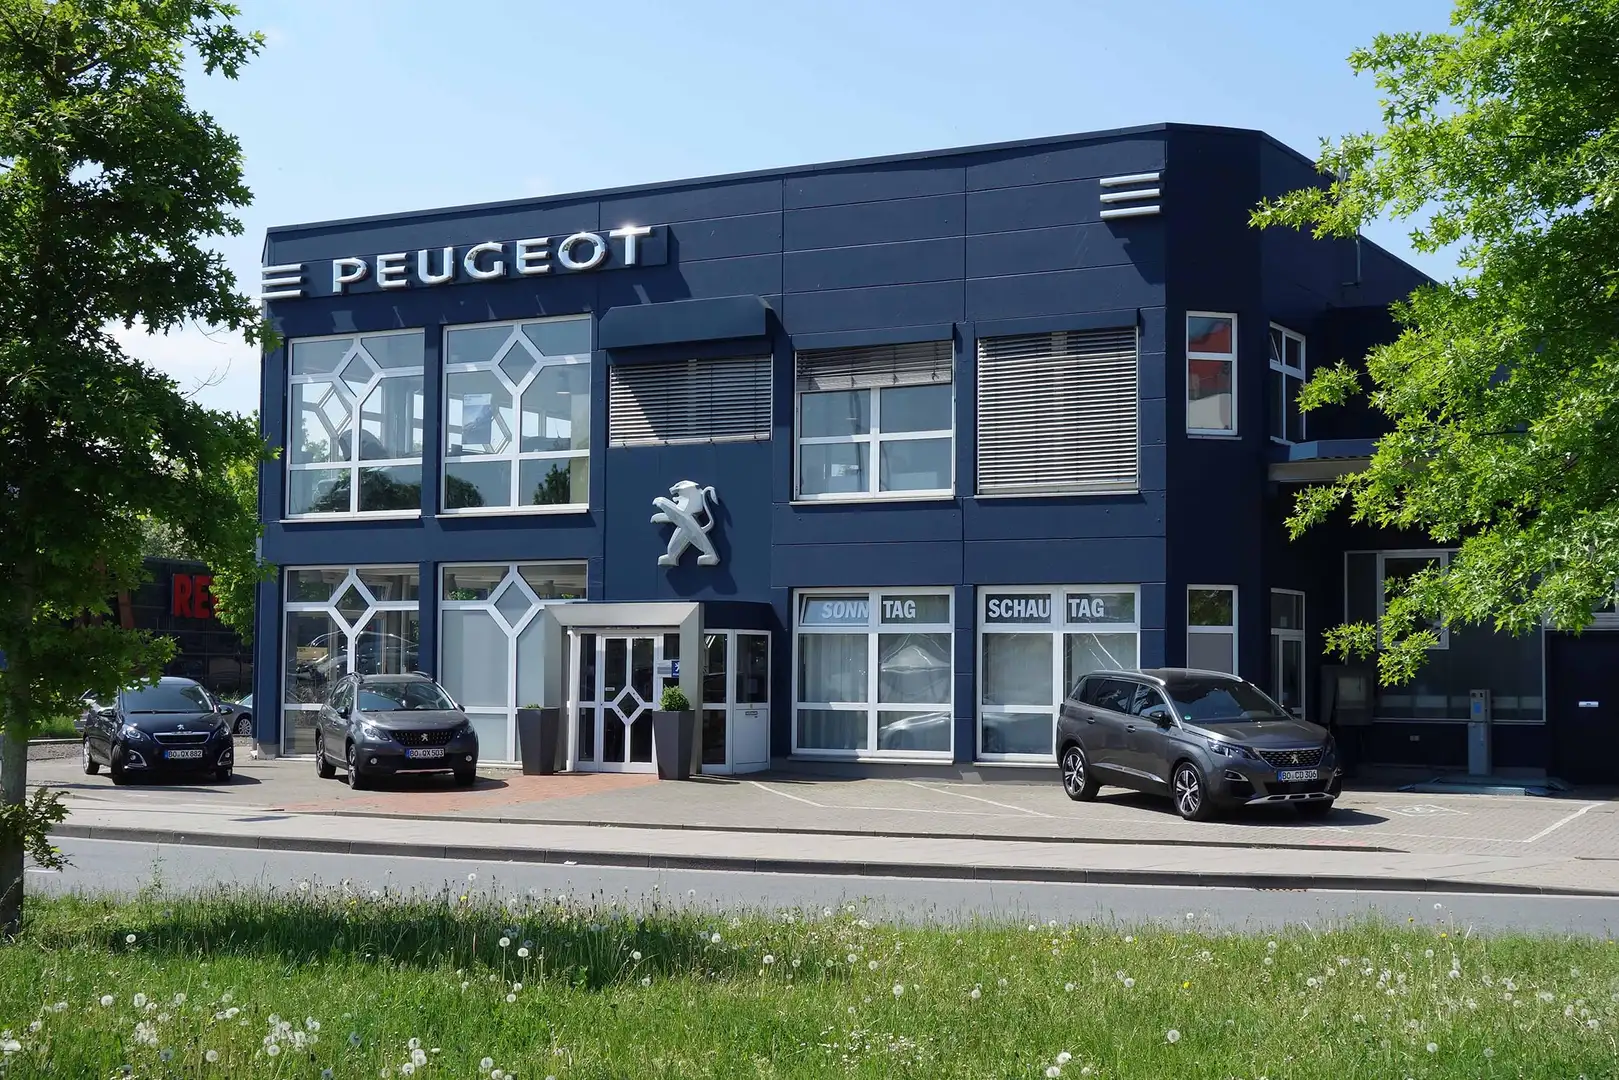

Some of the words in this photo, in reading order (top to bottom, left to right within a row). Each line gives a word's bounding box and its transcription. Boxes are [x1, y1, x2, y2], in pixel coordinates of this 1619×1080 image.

[332, 225, 652, 294] PEUGEOT
[821, 600, 869, 619] SONN
[883, 600, 916, 619] TAG
[988, 599, 1050, 618] SCHAU
[1068, 598, 1104, 618] TAG
[1304, 771, 1317, 779] 306
